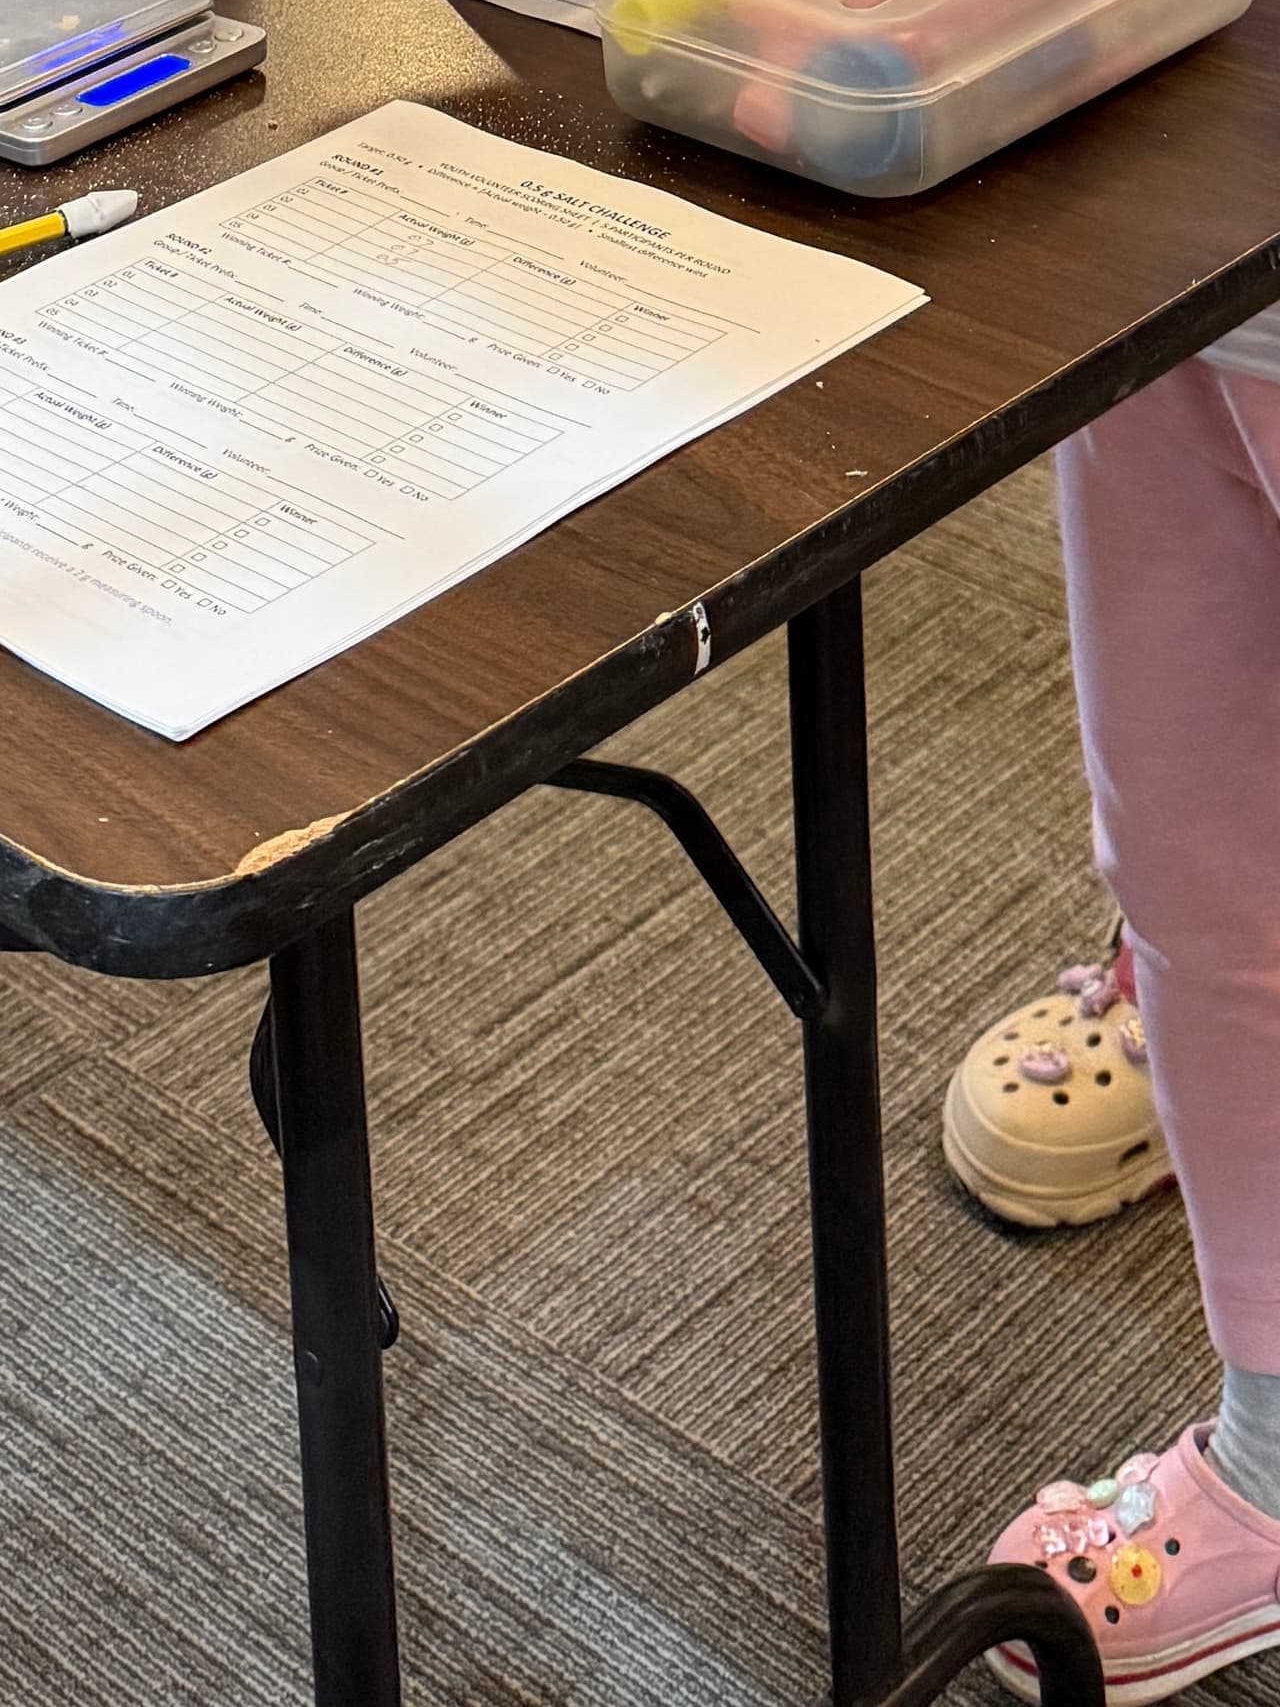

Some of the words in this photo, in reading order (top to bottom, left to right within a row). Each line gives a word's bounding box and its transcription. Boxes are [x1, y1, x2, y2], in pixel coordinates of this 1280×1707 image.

[332, 155, 370, 170] ROUND
[369, 168, 384, 176] #1
[314, 179, 341, 193] Ticket
[440, 163, 470, 176] YOUTH
[470, 174, 522, 196] VOLUNTEER
[520, 193, 562, 211] SCORING
[560, 208, 592, 221] SHEET
[608, 226, 674, 254] PARTICIPANTS
[674, 251, 694, 262] PER
[693, 259, 731, 274] ROUND
[520, 181, 544, 192] 0.5
[552, 193, 590, 208] SALT
[588, 205, 671, 239] CHALLENGE
[398, 214, 430, 228] Actual
[428, 226, 461, 241] Weight
[459, 238, 476, 247] (g)
[166, 233, 200, 249] ROUND
[198, 247, 212, 255] #2
[122, 271, 136, 279] 01
[144, 260, 172, 275] Ticket
[512, 256, 561, 279] Difference
[559, 277, 577, 286] (g)
[84, 289, 99, 297] 03
[103, 280, 118, 288] 02
[46, 307, 60, 316] 05
[153, 239, 180, 253] Group
[185, 253, 212, 268] Ticket
[298, 302, 324, 315] Time:
[410, 347, 458, 372] Volunteer:
[224, 297, 257, 311] Actual
[254, 309, 288, 325] Weight
[284, 322, 302, 331] (g)
[634, 305, 670, 321] Winner
[12, 337, 27, 345] #3
[343, 347, 392, 370] Difference
[390, 367, 408, 377] (g)
[34, 392, 66, 408] Actual
[64, 405, 98, 423] Weight
[94, 419, 112, 429] (g)
[470, 400, 508, 419] Winner
[152, 446, 202, 472] Difference
[199, 469, 218, 479] (g)
[280, 504, 318, 525] Winner
